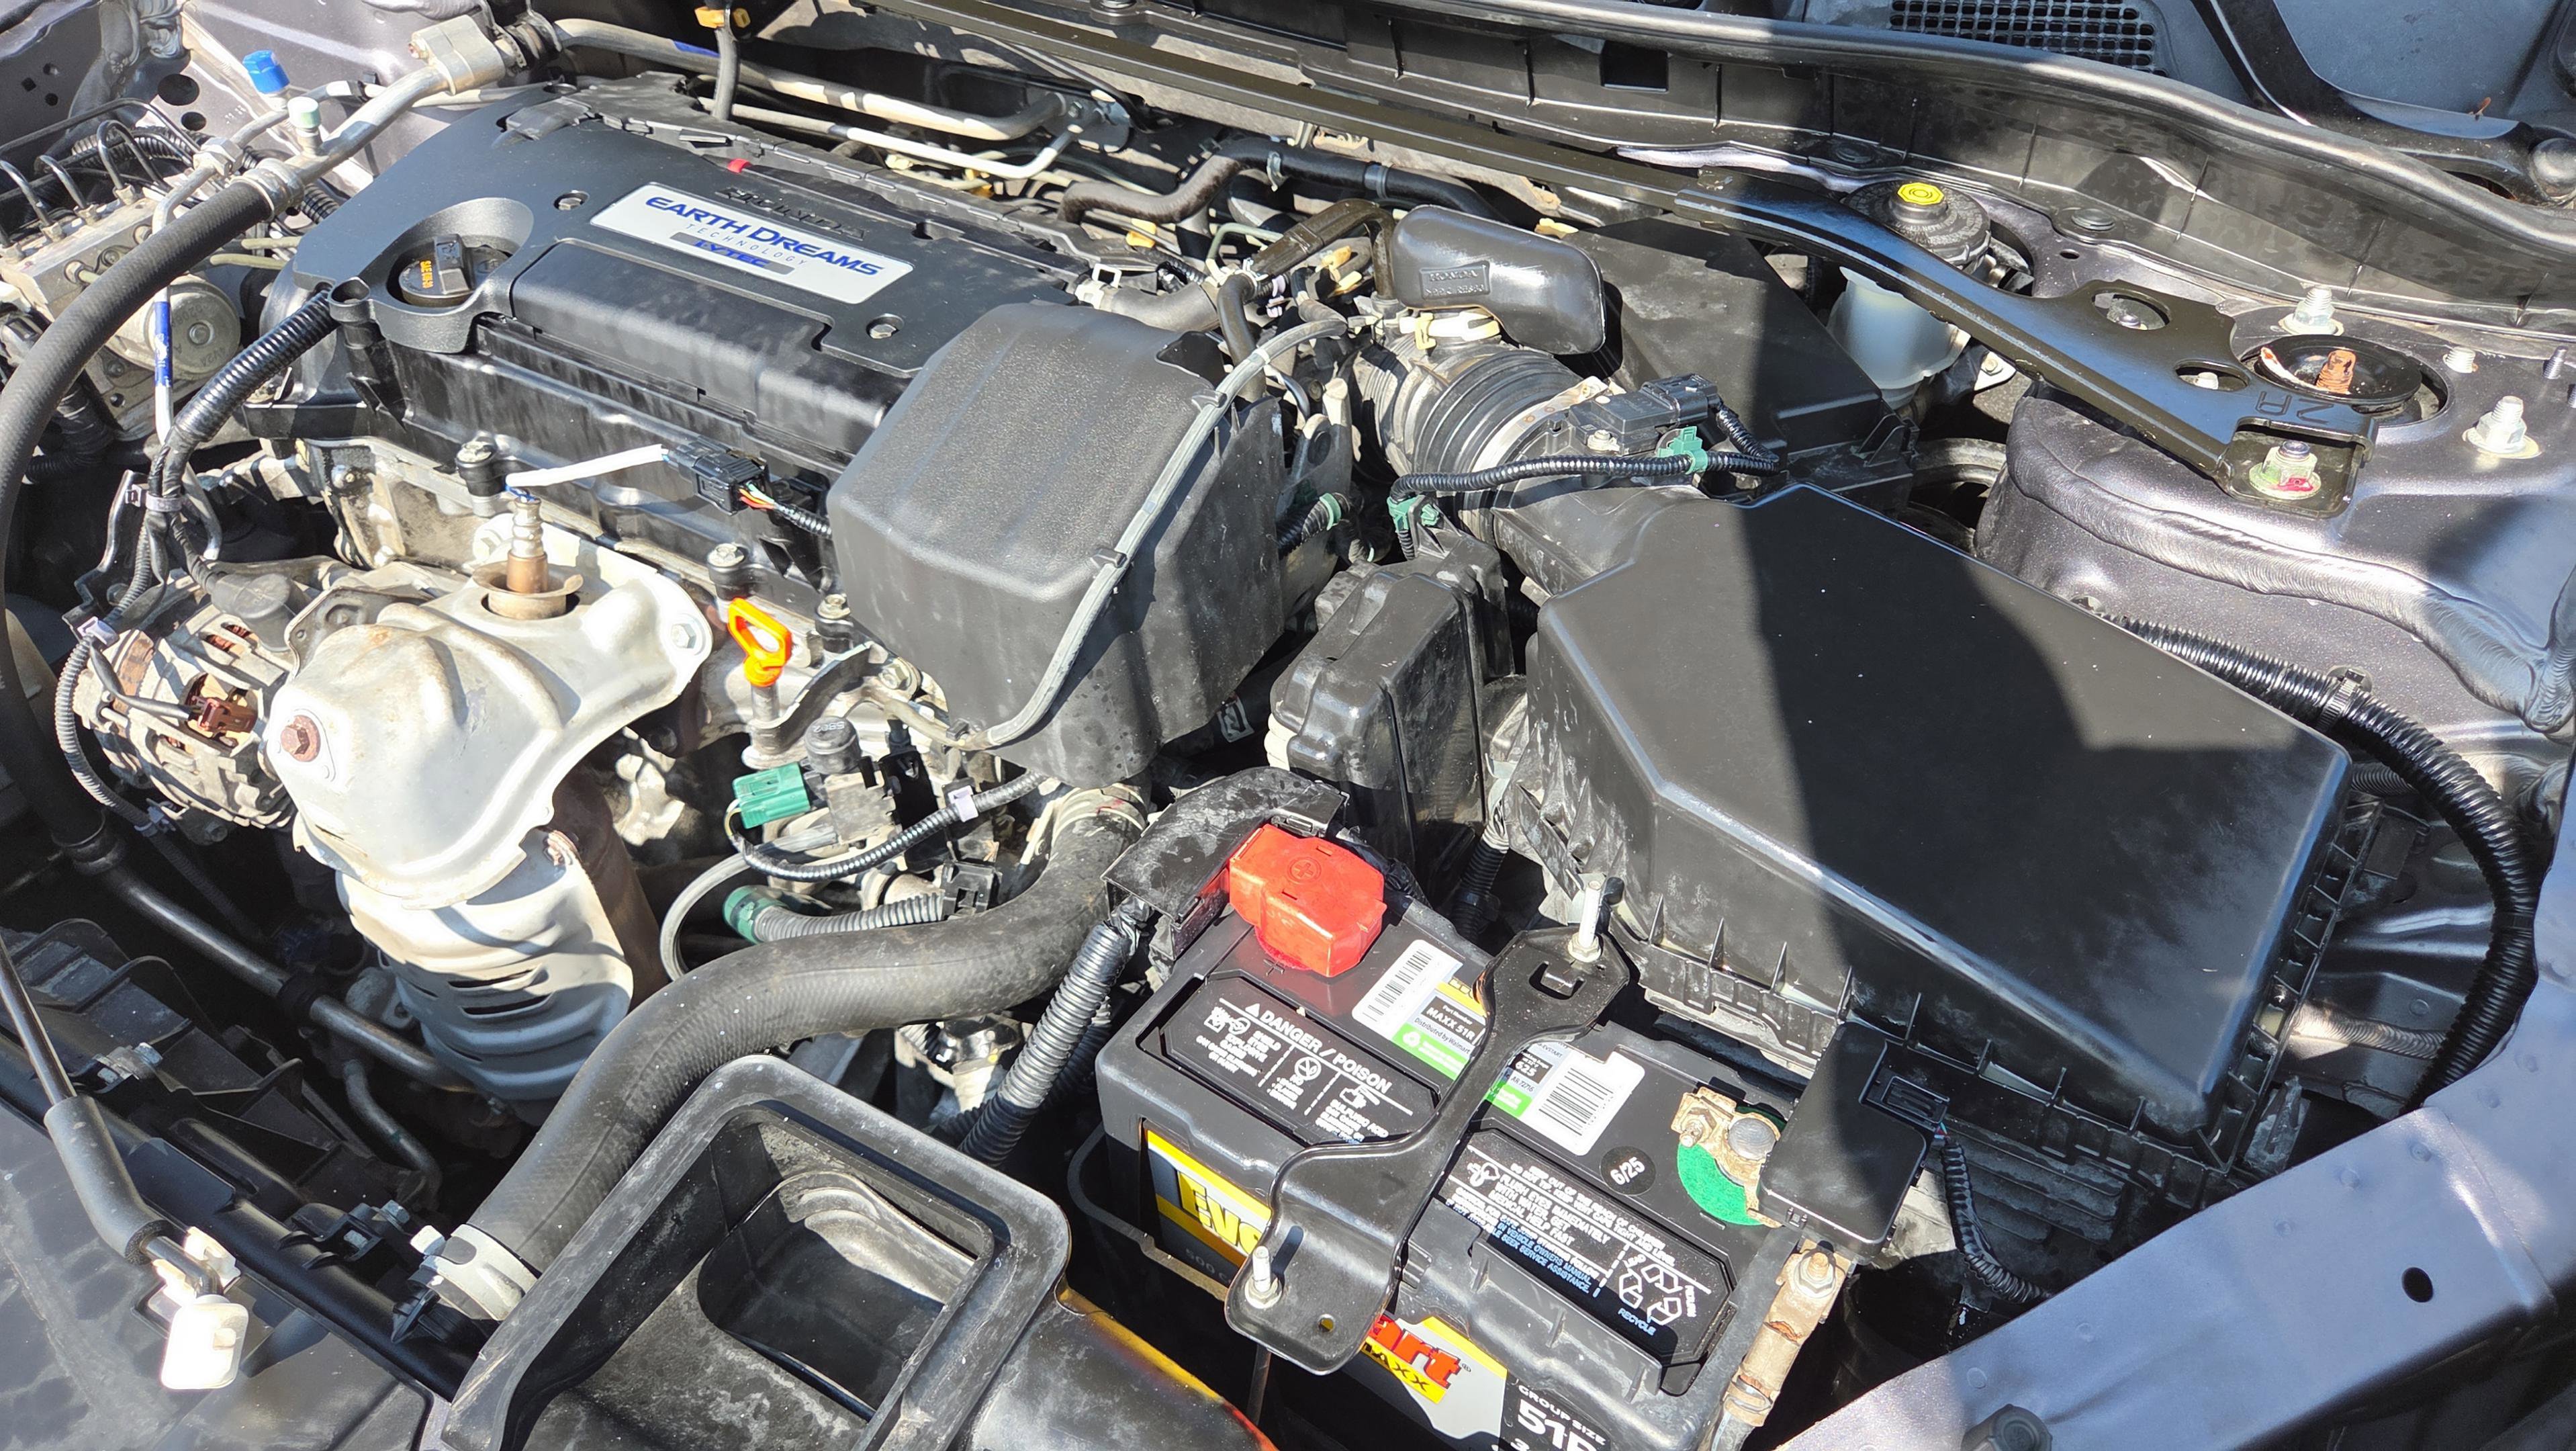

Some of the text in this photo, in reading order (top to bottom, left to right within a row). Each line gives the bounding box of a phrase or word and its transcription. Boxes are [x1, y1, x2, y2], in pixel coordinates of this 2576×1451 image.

[645, 197, 885, 275] EARTH DREAMS
[686, 223, 808, 266] TECHNOLOGY
[1426, 1007, 1475, 1040] MAXX 51R
[1442, 1005, 1453, 1014] Part
[1260, 1010, 1323, 1053] DANGER
[1332, 1053, 1393, 1094] POISON
[1414, 1018, 1470, 1054] Distributed by Walmart
[1511, 1076, 1519, 1084] AR
[1515, 1061, 1536, 1077] 625
[1611, 1157, 1645, 1184] 6/25
[1488, 1190, 1575, 1245] MEDICAL HELP FAST
[1495, 1182, 1518, 1201] WITH
[1550, 1216, 1571, 1231] GET
[1528, 1192, 1550, 1210] EYES
[1552, 1206, 1610, 1244] IMMEDIATELY
[1507, 1227, 1534, 1248] VEHICLE
[1534, 1245, 1563, 1266] OWNERS
[1519, 1245, 1548, 1266] SERVICE
[1618, 1308, 1656, 1335] RECYCLE
[1518, 1384, 1606, 1446] GROUP SIZE
